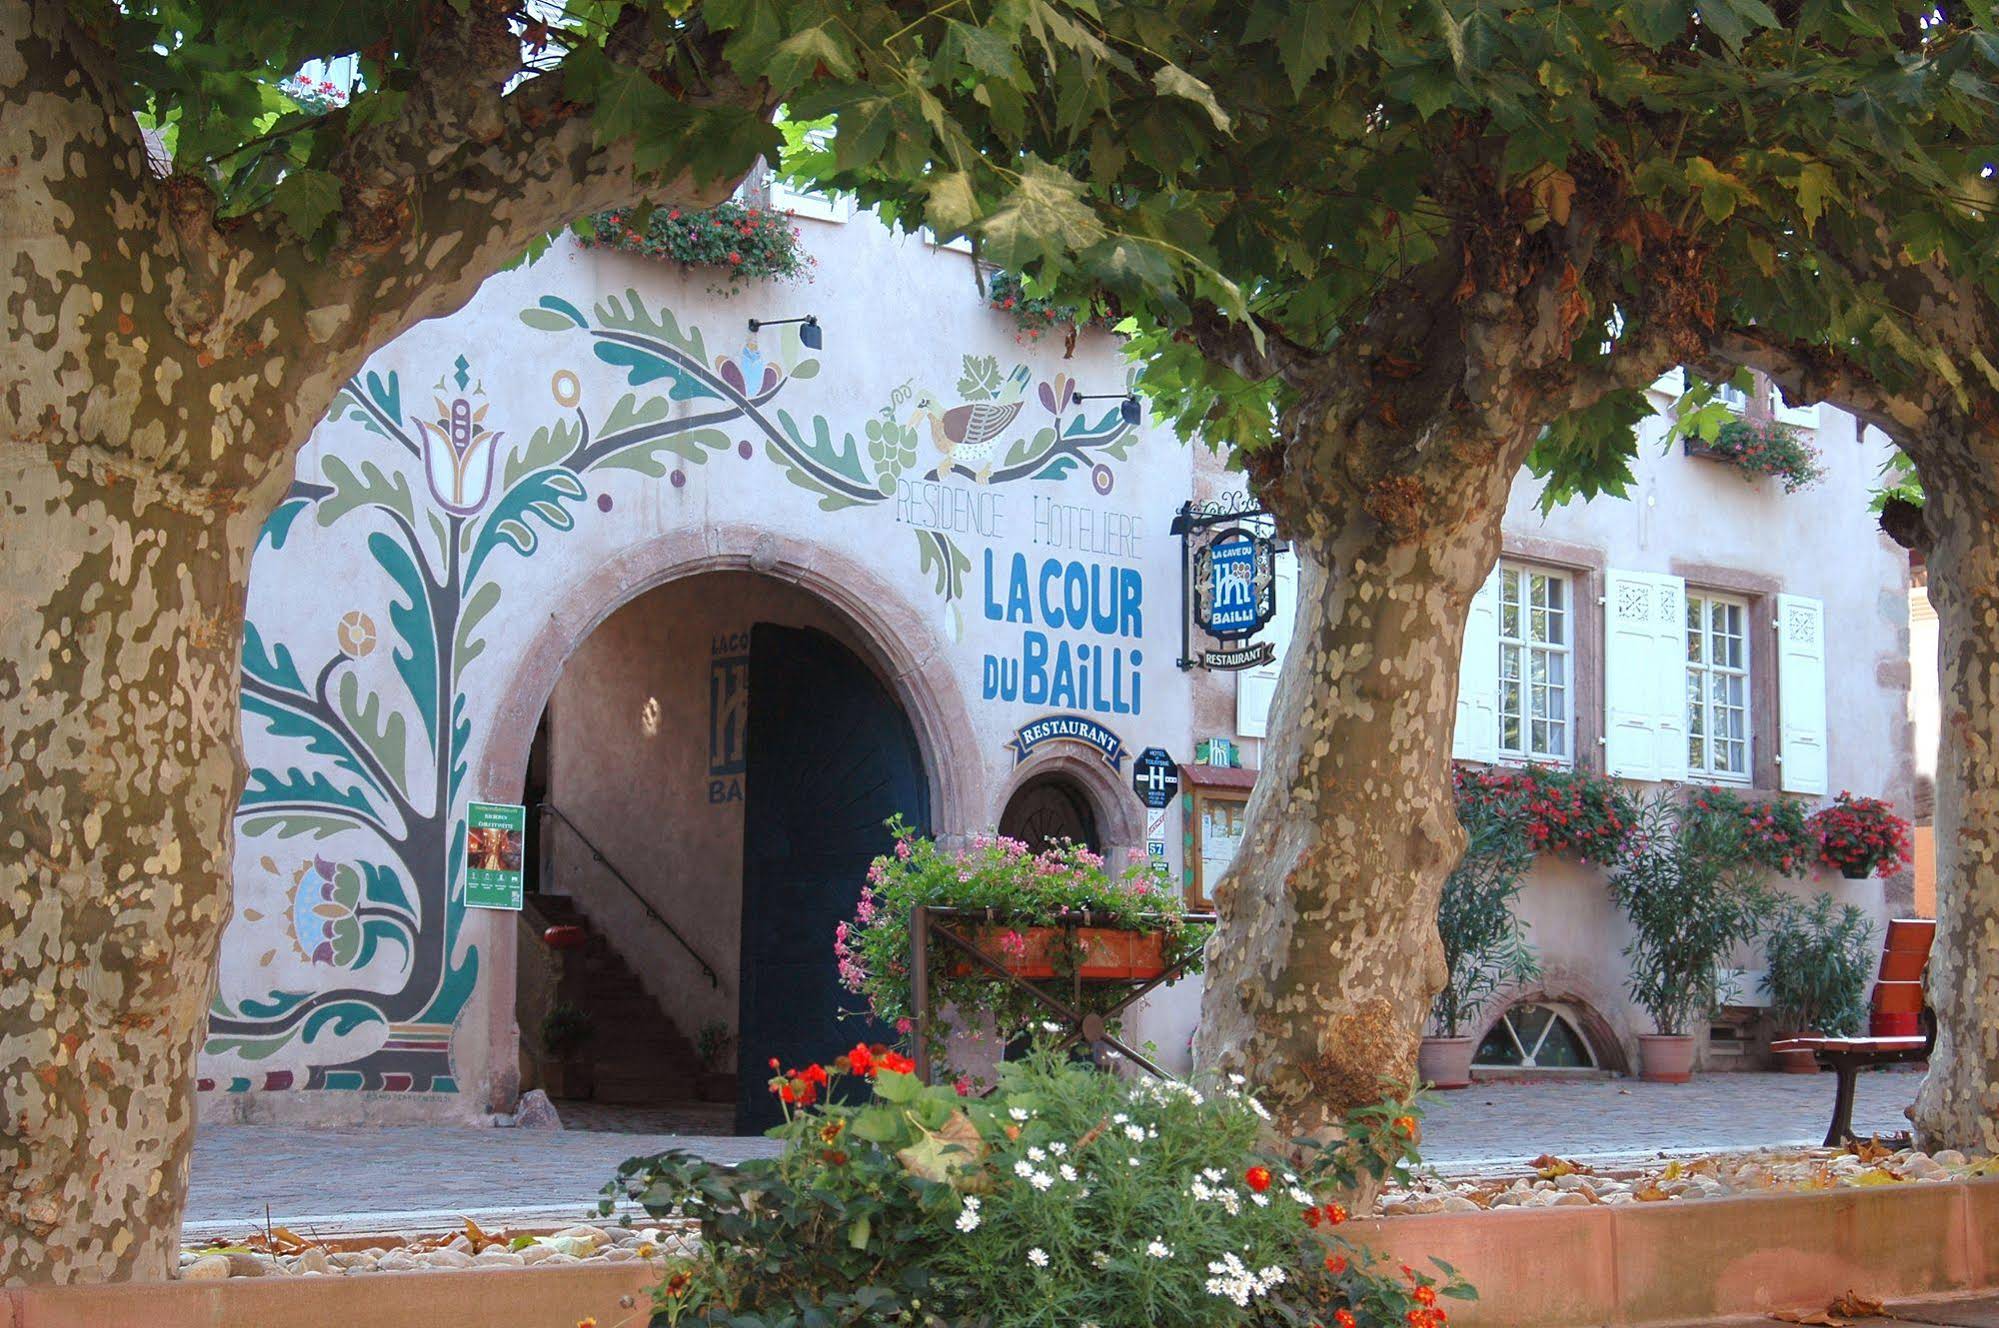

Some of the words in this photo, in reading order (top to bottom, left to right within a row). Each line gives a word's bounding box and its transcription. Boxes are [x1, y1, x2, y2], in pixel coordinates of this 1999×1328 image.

[1212, 551, 1222, 560] LA
[1223, 548, 1241, 558] CAVE
[984, 547, 1032, 624] LA
[1039, 558, 1142, 638] COUR
[1206, 648, 1262, 666] RESTAURANT
[983, 654, 1018, 702] DU
[1022, 720, 1117, 751] RESTAURANT
[1149, 766, 1164, 790] H
